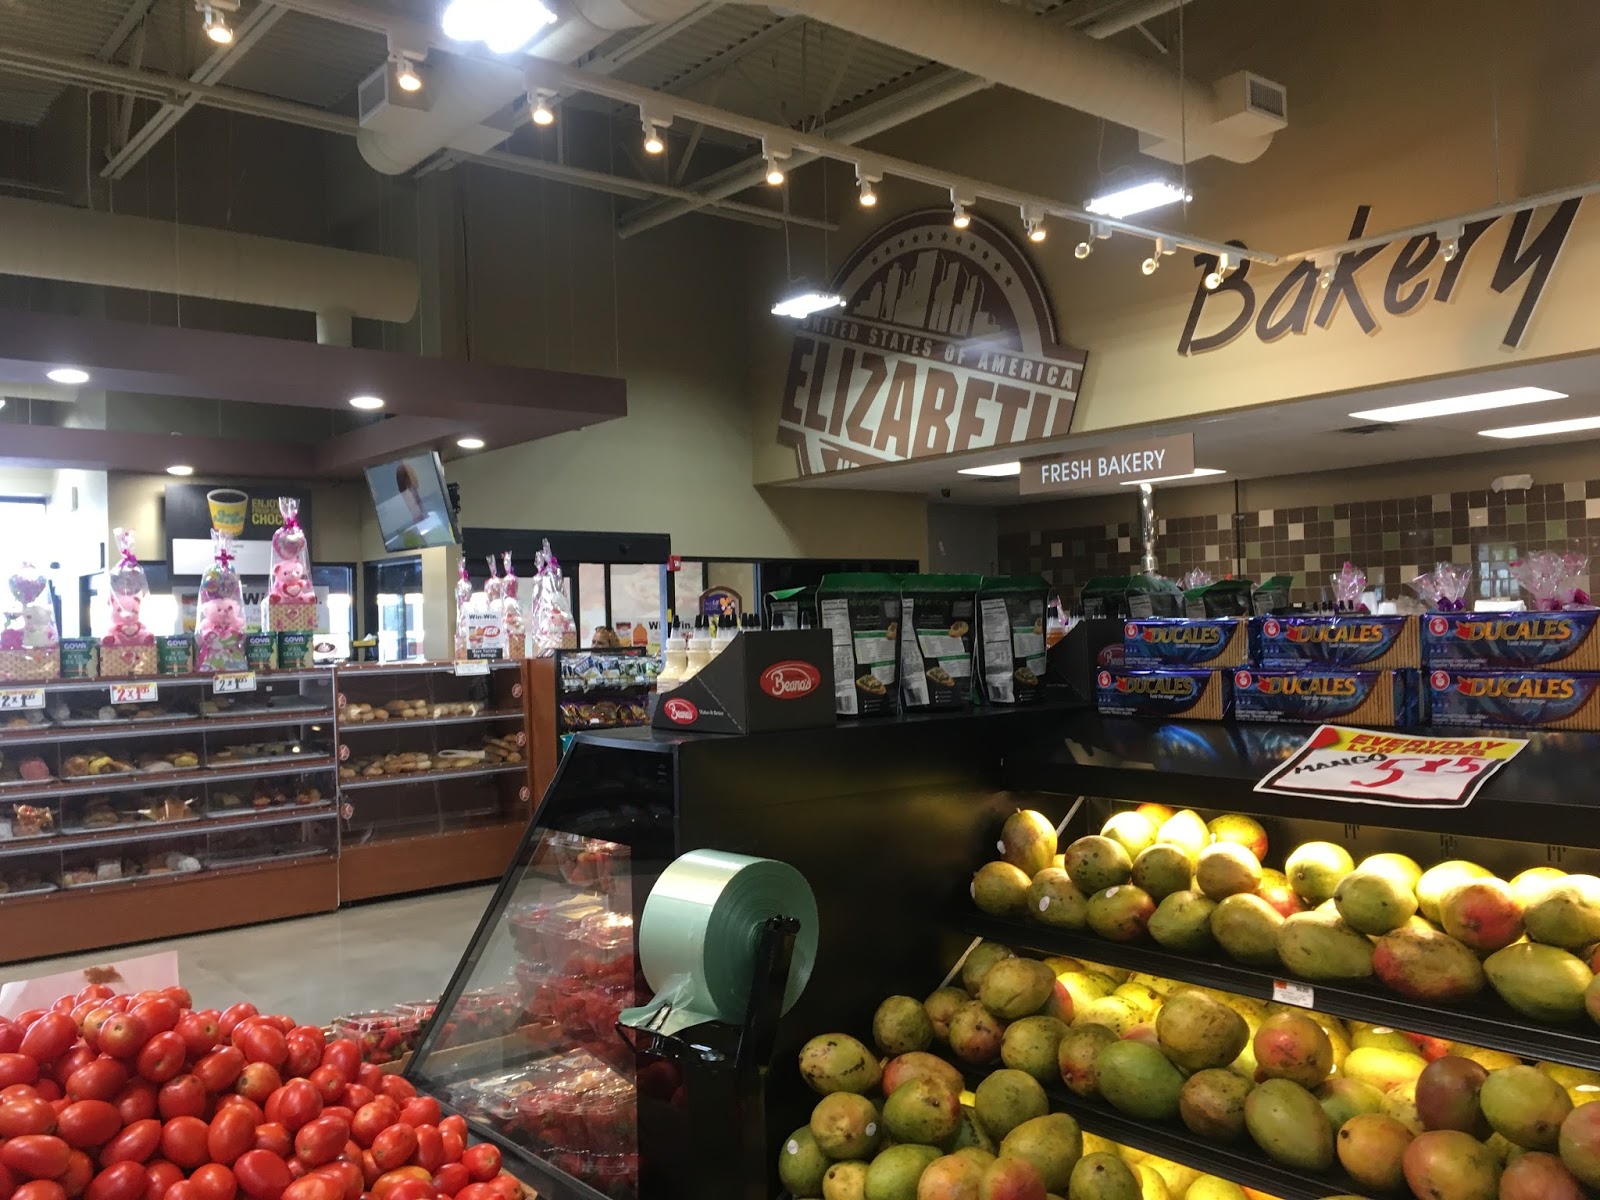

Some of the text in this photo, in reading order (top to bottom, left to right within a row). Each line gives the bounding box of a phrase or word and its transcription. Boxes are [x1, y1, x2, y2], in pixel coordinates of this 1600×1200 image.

[1177, 197, 1583, 357] Bakery
[802, 318, 1074, 390] UNITED STATES OF AMERICA
[1041, 449, 1166, 485] FRESH BAKERY
[251, 513, 287, 526] CHOC
[1152, 626, 1221, 644] DUCALES
[1297, 624, 1384, 643] DUCALES
[1470, 618, 1573, 641] DUCALES
[1126, 676, 1194, 695] DUCALES
[1269, 675, 1358, 696] DUCALES
[1471, 677, 1576, 698] DUCALES
[1346, 744, 1487, 757] LOW PRICES
[1349, 734, 1506, 751] EVERYDAY
[1294, 753, 1389, 775] MANGO
[1350, 757, 1422, 788] 5
[1442, 756, 1486, 774] 5
